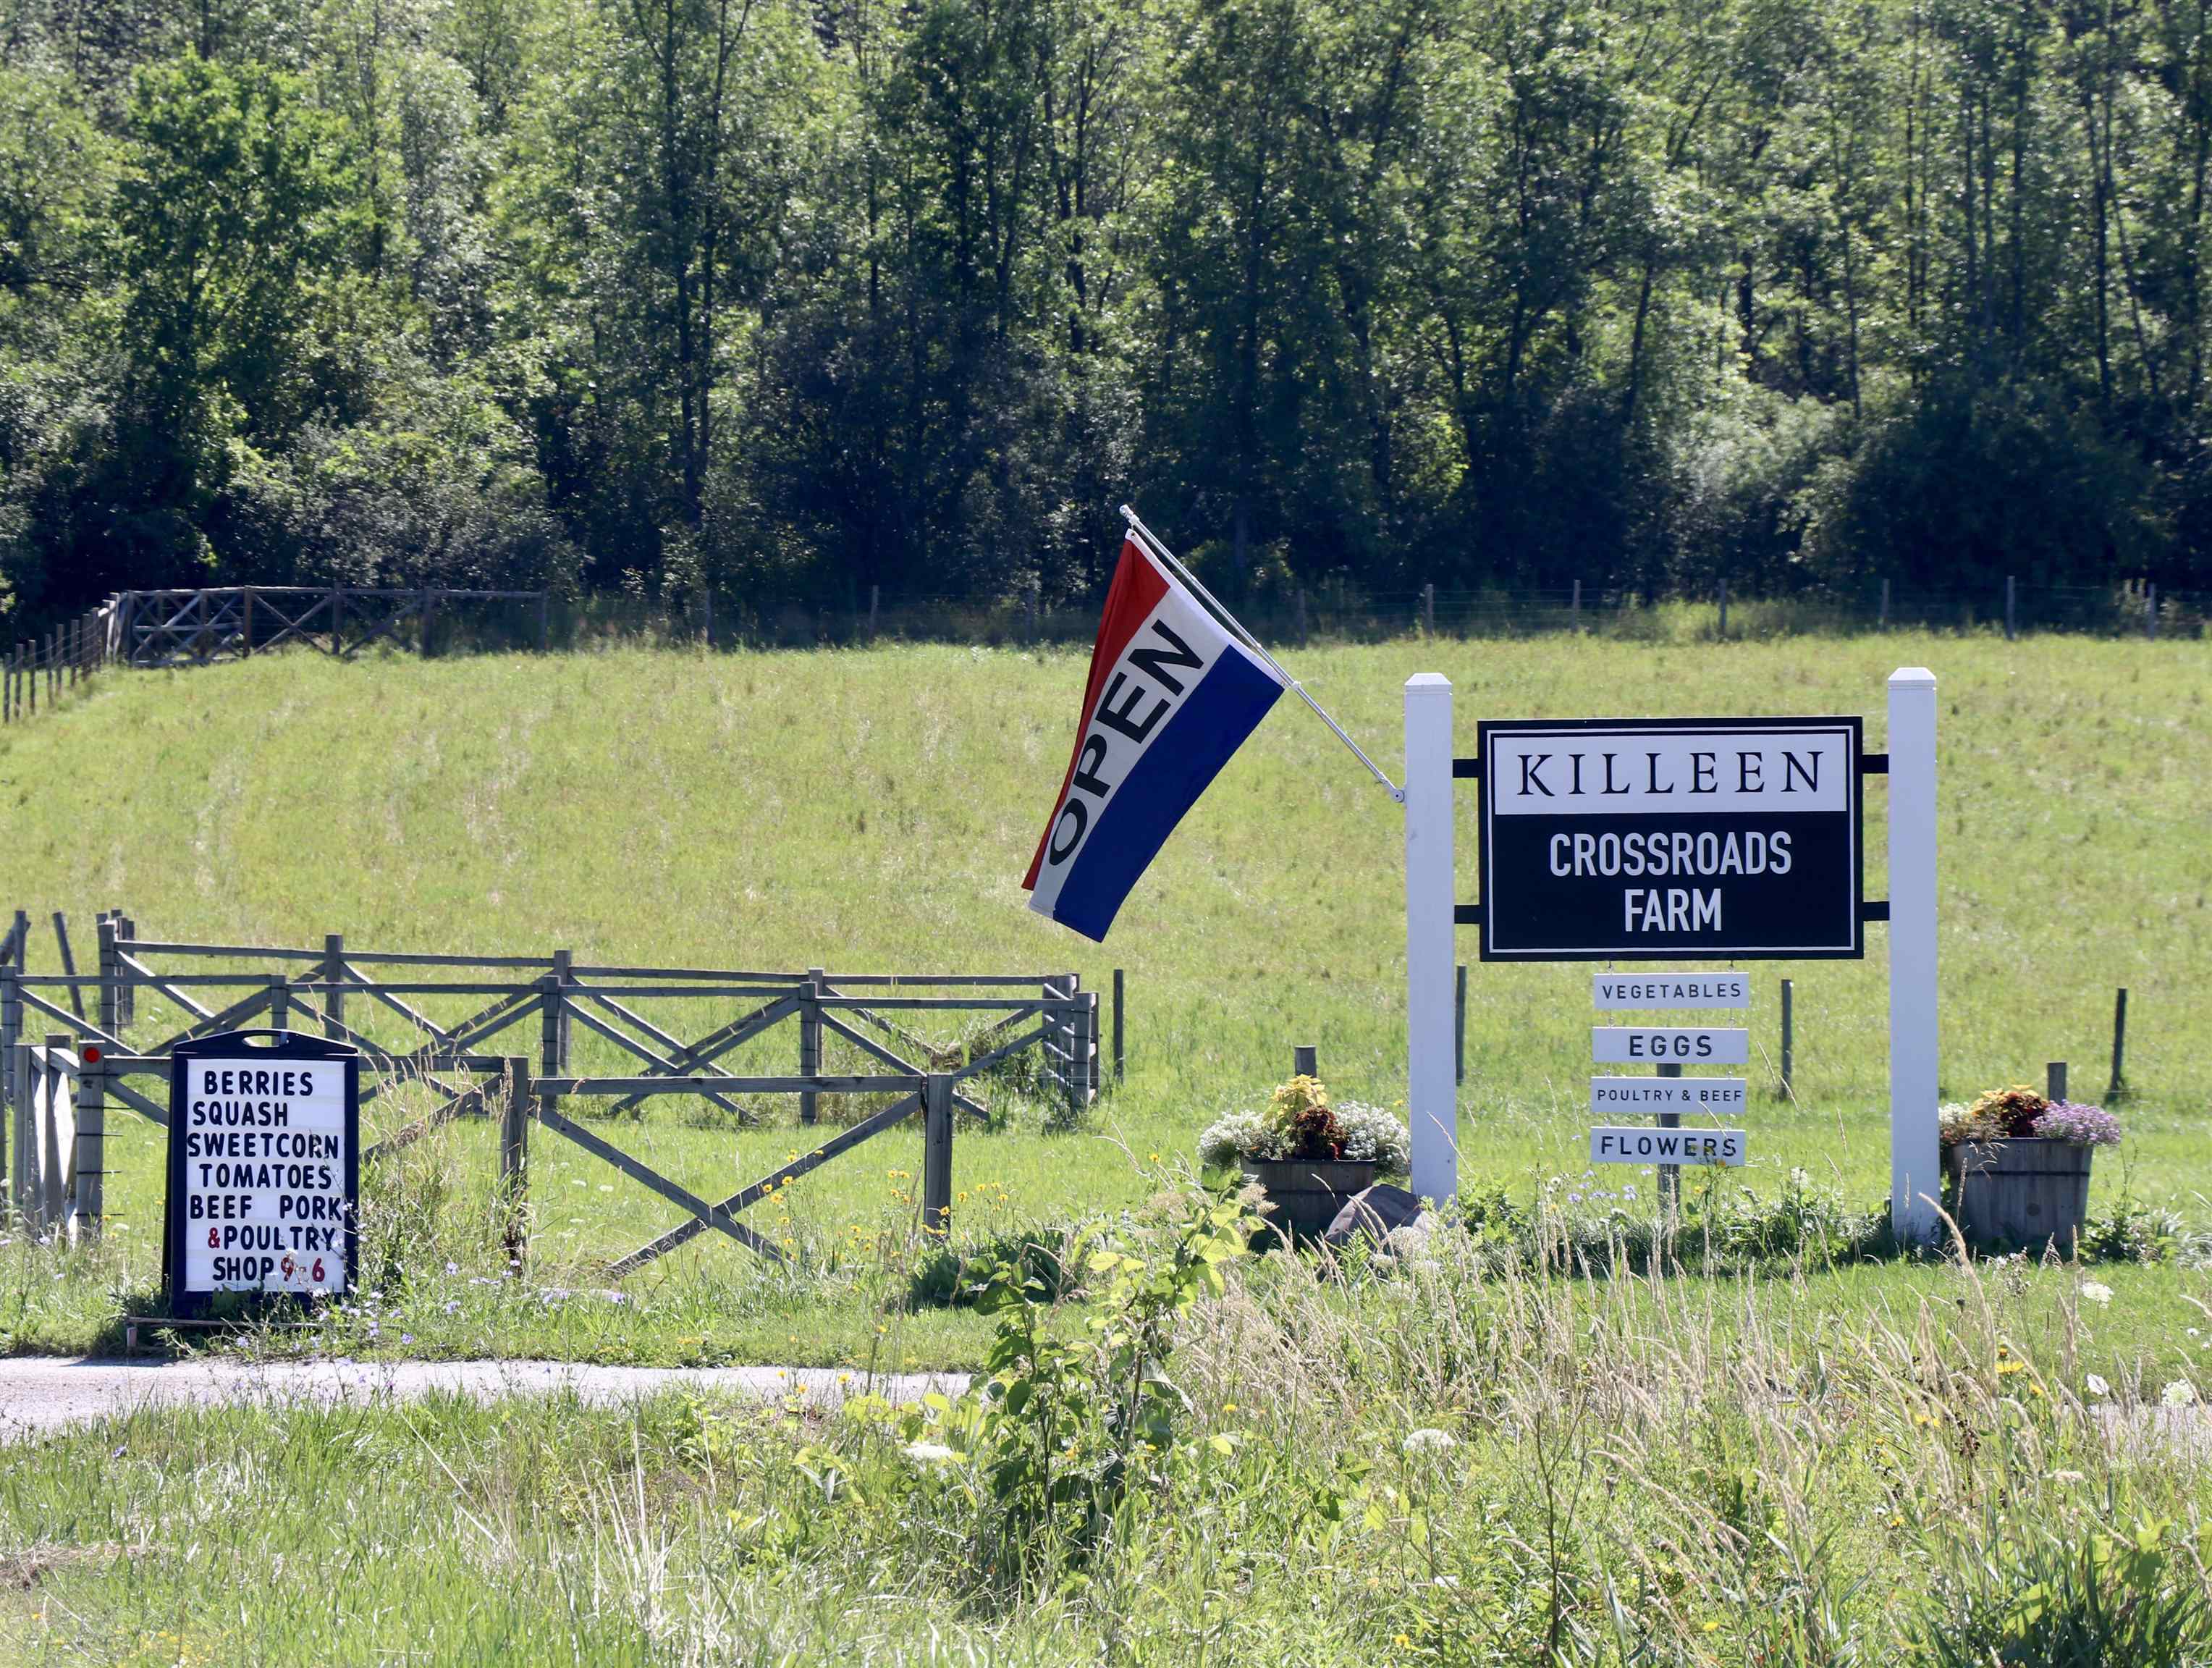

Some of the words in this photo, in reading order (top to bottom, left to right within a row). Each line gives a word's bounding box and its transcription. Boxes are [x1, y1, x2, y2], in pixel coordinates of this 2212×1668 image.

[1048, 619, 1204, 866] OPEN
[1517, 751, 1824, 796] KILLEEN
[1550, 830, 1792, 877] CROSSROADS
[1624, 888, 1722, 932] FARM
[1603, 983, 1741, 999] VEGETABLES
[1629, 1035, 1712, 1057] EGGS
[204, 1071, 313, 1096] BERRIES
[1597, 1090, 1673, 1101] POULTRY
[1681, 1090, 1691, 1101] &
[1700, 1090, 1742, 1101] BEEF
[193, 1101, 288, 1126] SQUASH
[187, 1132, 339, 1159] SWEETCORN
[1601, 1136, 1736, 1157] FLOWERS
[199, 1163, 332, 1189] TOMATOES
[190, 1195, 253, 1219] BEEF
[279, 1195, 342, 1221] PORK
[213, 1256, 274, 1281] SHOP
